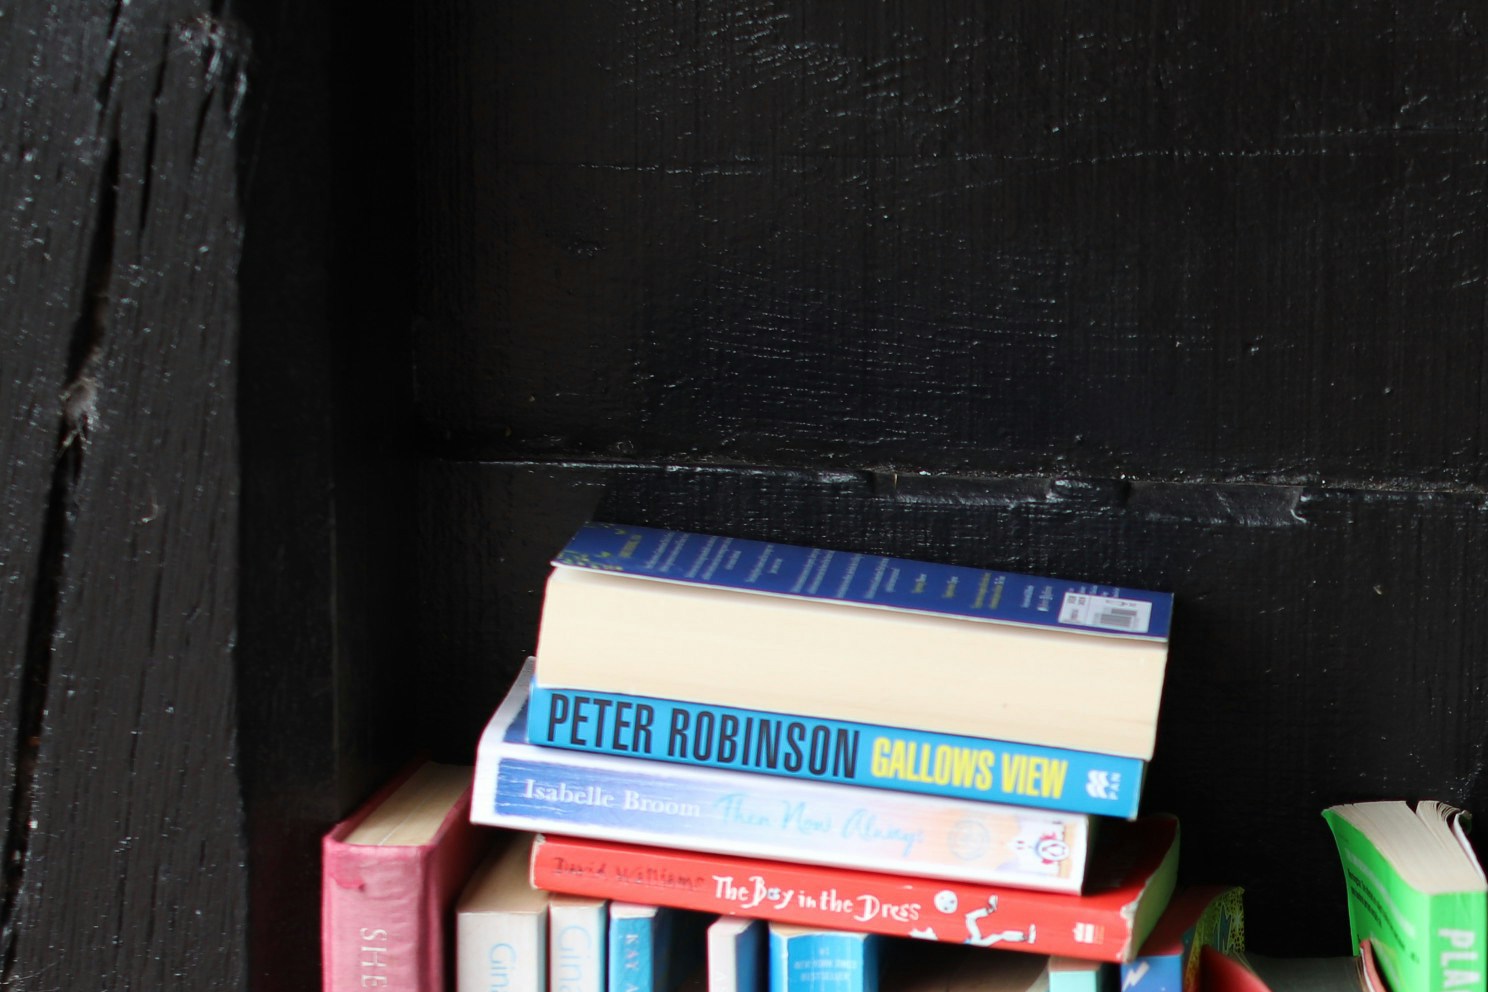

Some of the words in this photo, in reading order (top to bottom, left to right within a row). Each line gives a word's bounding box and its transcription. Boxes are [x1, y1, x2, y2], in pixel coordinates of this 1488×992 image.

[548, 693, 655, 754] PETER
[667, 707, 860, 779] ROBINSON
[870, 736, 996, 791] GALLOWS
[1001, 752, 1068, 799] VIEW
[524, 779, 614, 809] Isabelle
[623, 789, 701, 818] Broom
[712, 791, 772, 828] Then
[780, 800, 832, 836] Now
[711, 873, 750, 899] The
[747, 875, 795, 910] Boy
[797, 889, 817, 908] in
[819, 885, 853, 913] the
[853, 893, 922, 922] Dress
[624, 934, 640, 972] KAY
